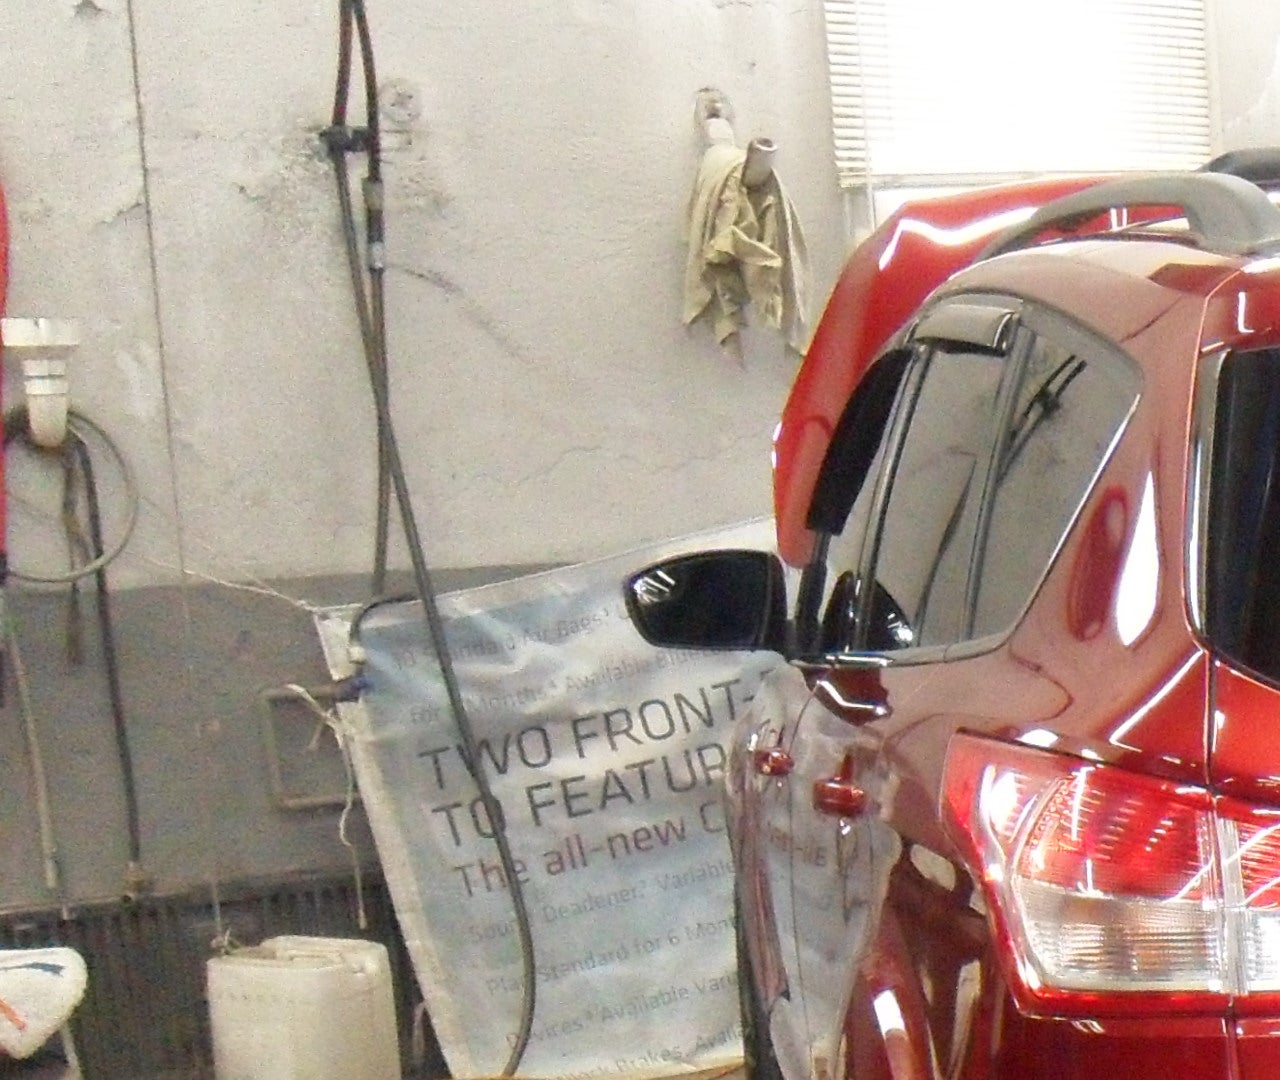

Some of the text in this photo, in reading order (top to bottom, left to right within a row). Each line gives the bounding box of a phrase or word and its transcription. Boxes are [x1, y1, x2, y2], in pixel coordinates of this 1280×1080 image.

[418, 668, 772, 790] TWO FRONT-
[431, 794, 507, 847] TO
[454, 856, 530, 898] The
[544, 816, 687, 876] all-new
